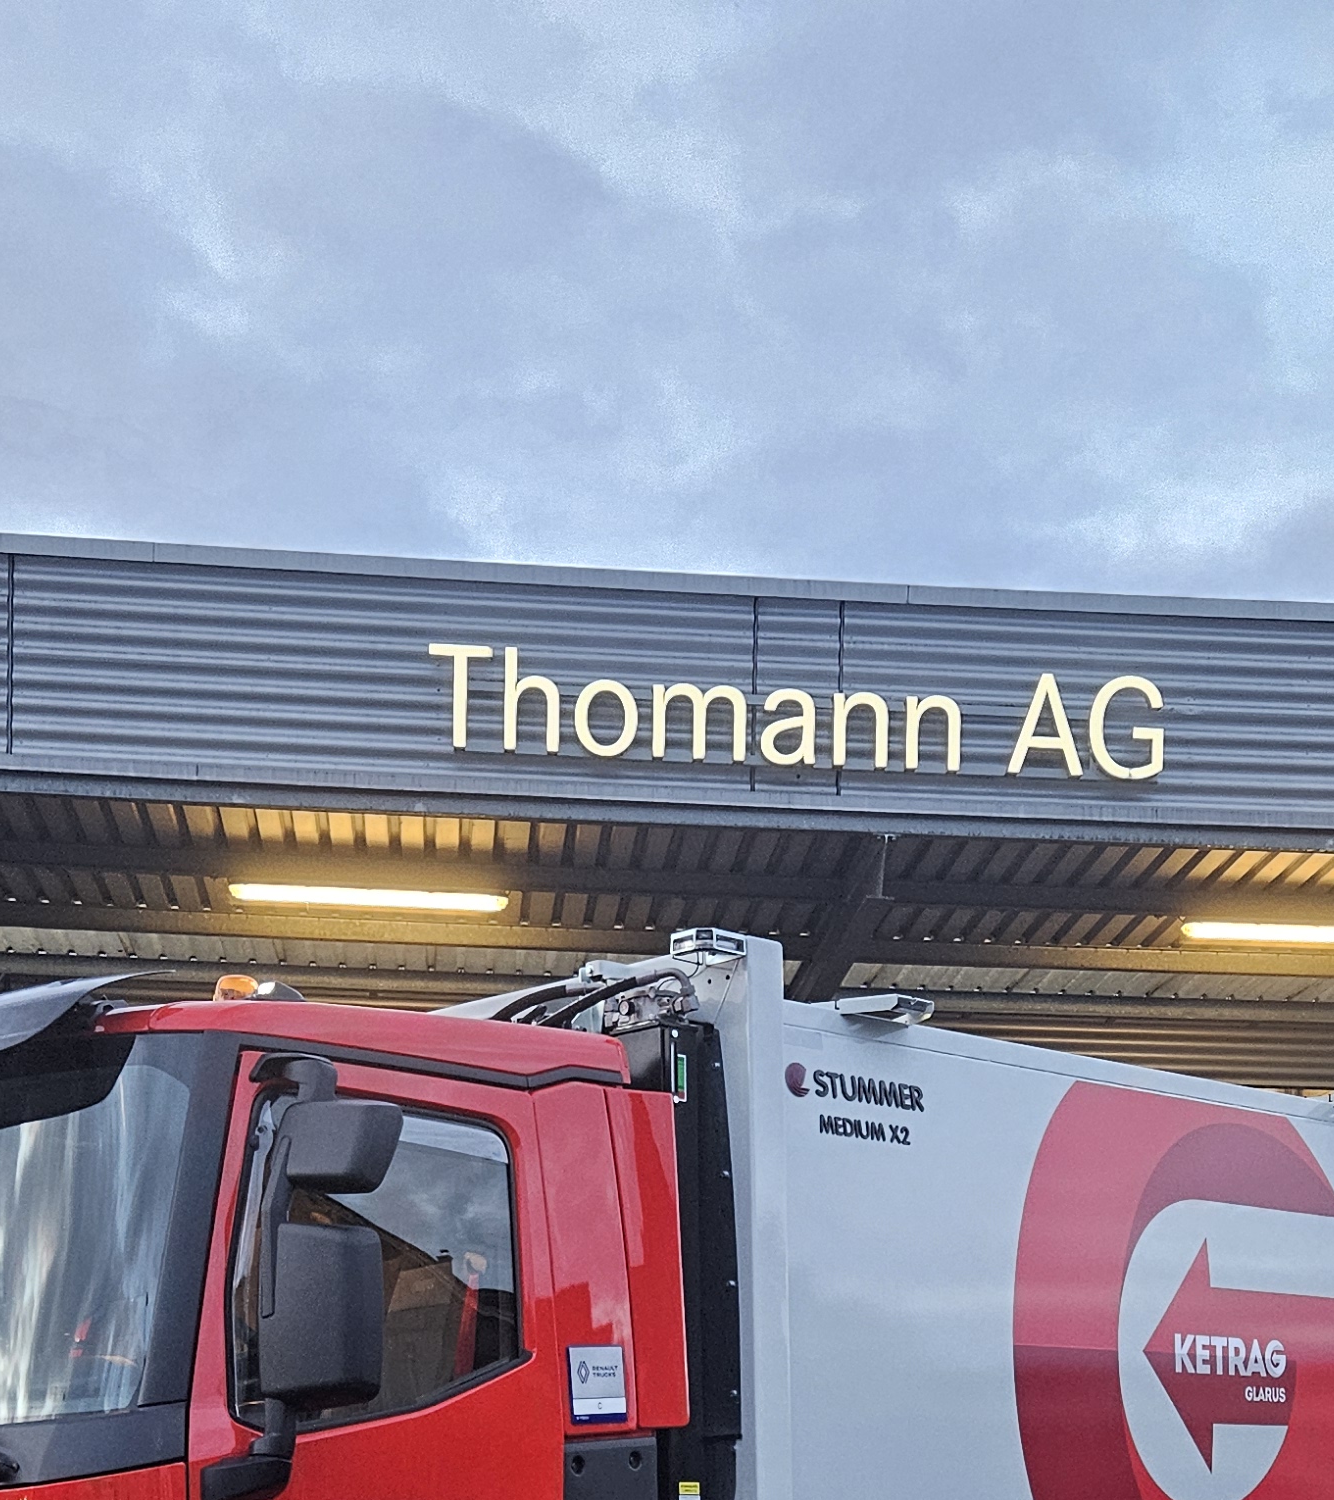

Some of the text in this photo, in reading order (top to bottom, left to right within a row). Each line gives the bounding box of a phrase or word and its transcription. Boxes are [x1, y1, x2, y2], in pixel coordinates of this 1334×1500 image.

[428, 642, 1166, 781] Thomann AG
[813, 1069, 924, 1112] STUMMER
[820, 1114, 911, 1146] MEDIUM X2
[1174, 1333, 1287, 1379] KETRAG
[1244, 1386, 1286, 1403] GLARUS
